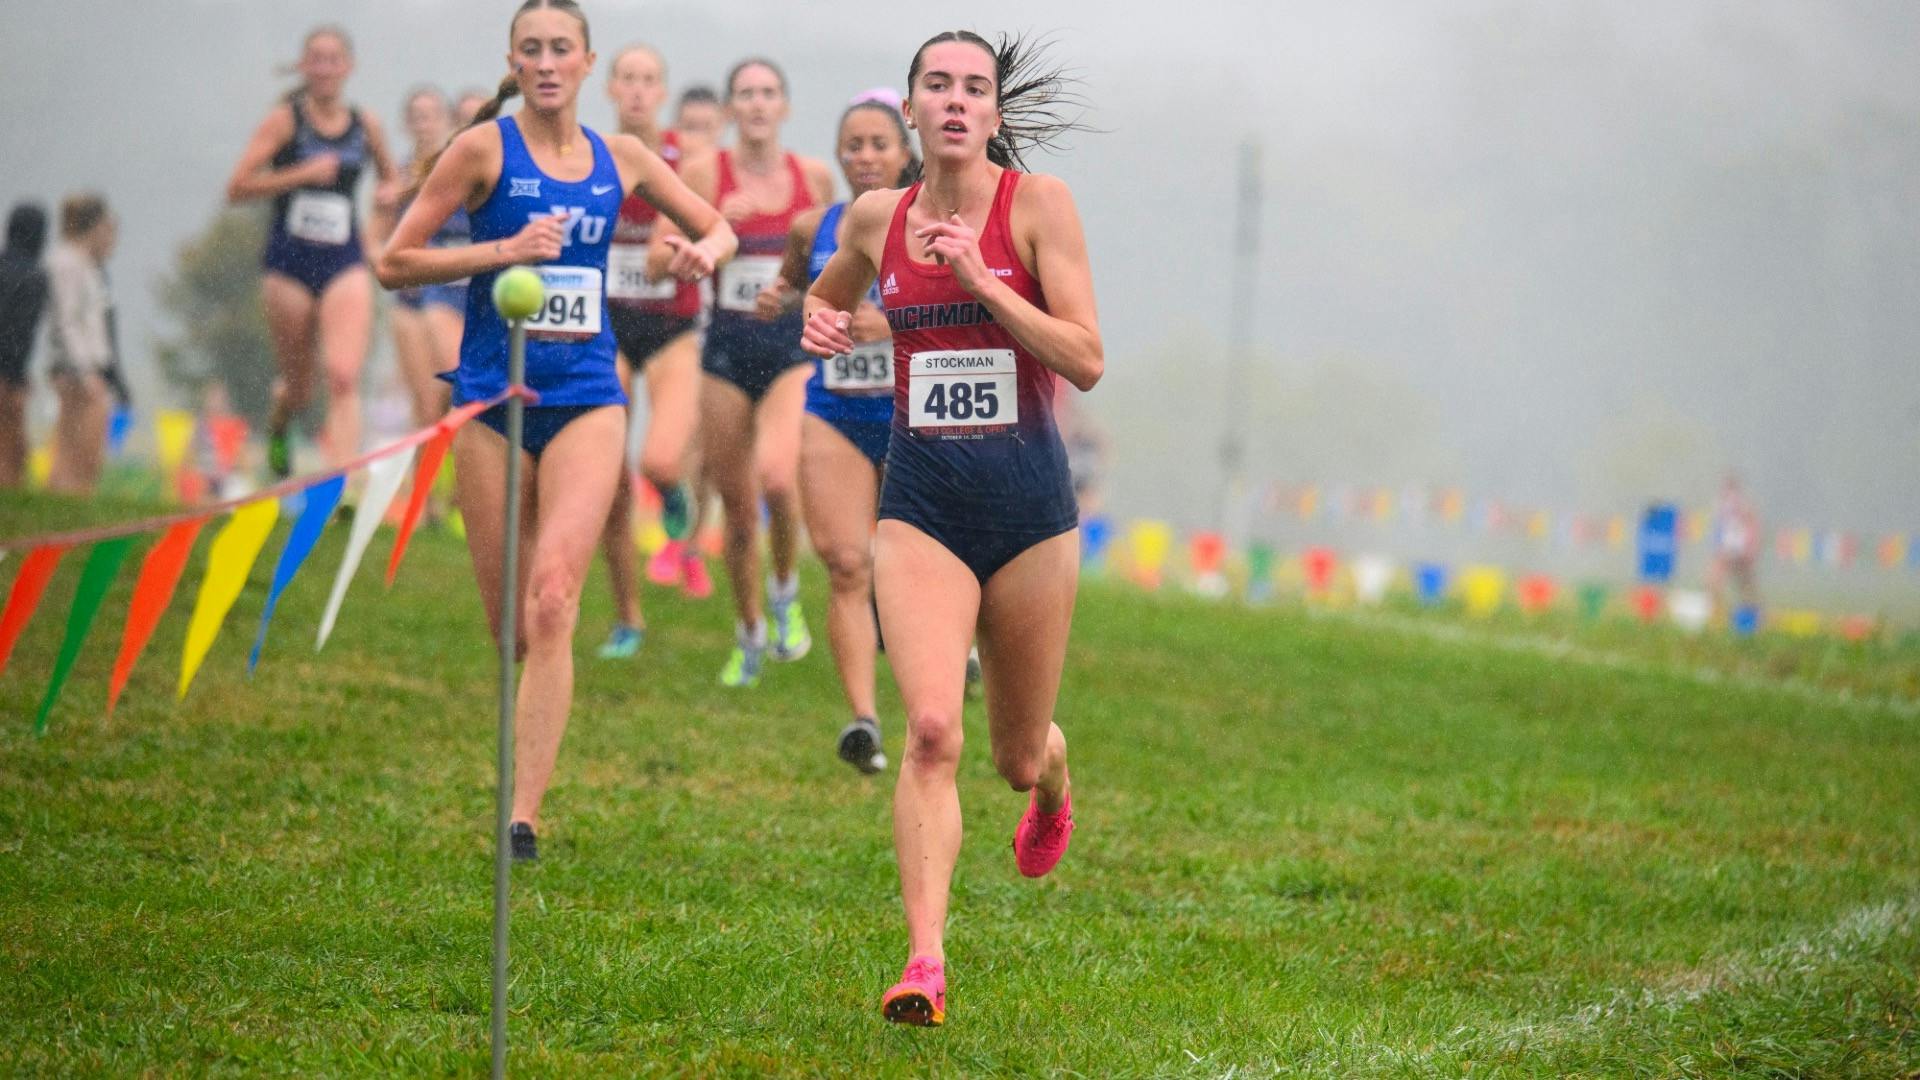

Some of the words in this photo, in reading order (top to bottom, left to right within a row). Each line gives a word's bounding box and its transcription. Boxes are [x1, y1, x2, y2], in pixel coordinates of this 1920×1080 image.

[528, 205, 607, 247] YU
[886, 301, 996, 332] RICHMON
[834, 354, 887, 380] 993
[925, 356, 994, 369] STOCKMAN
[924, 382, 998, 420] 485
[985, 423, 1008, 433] OPEN
